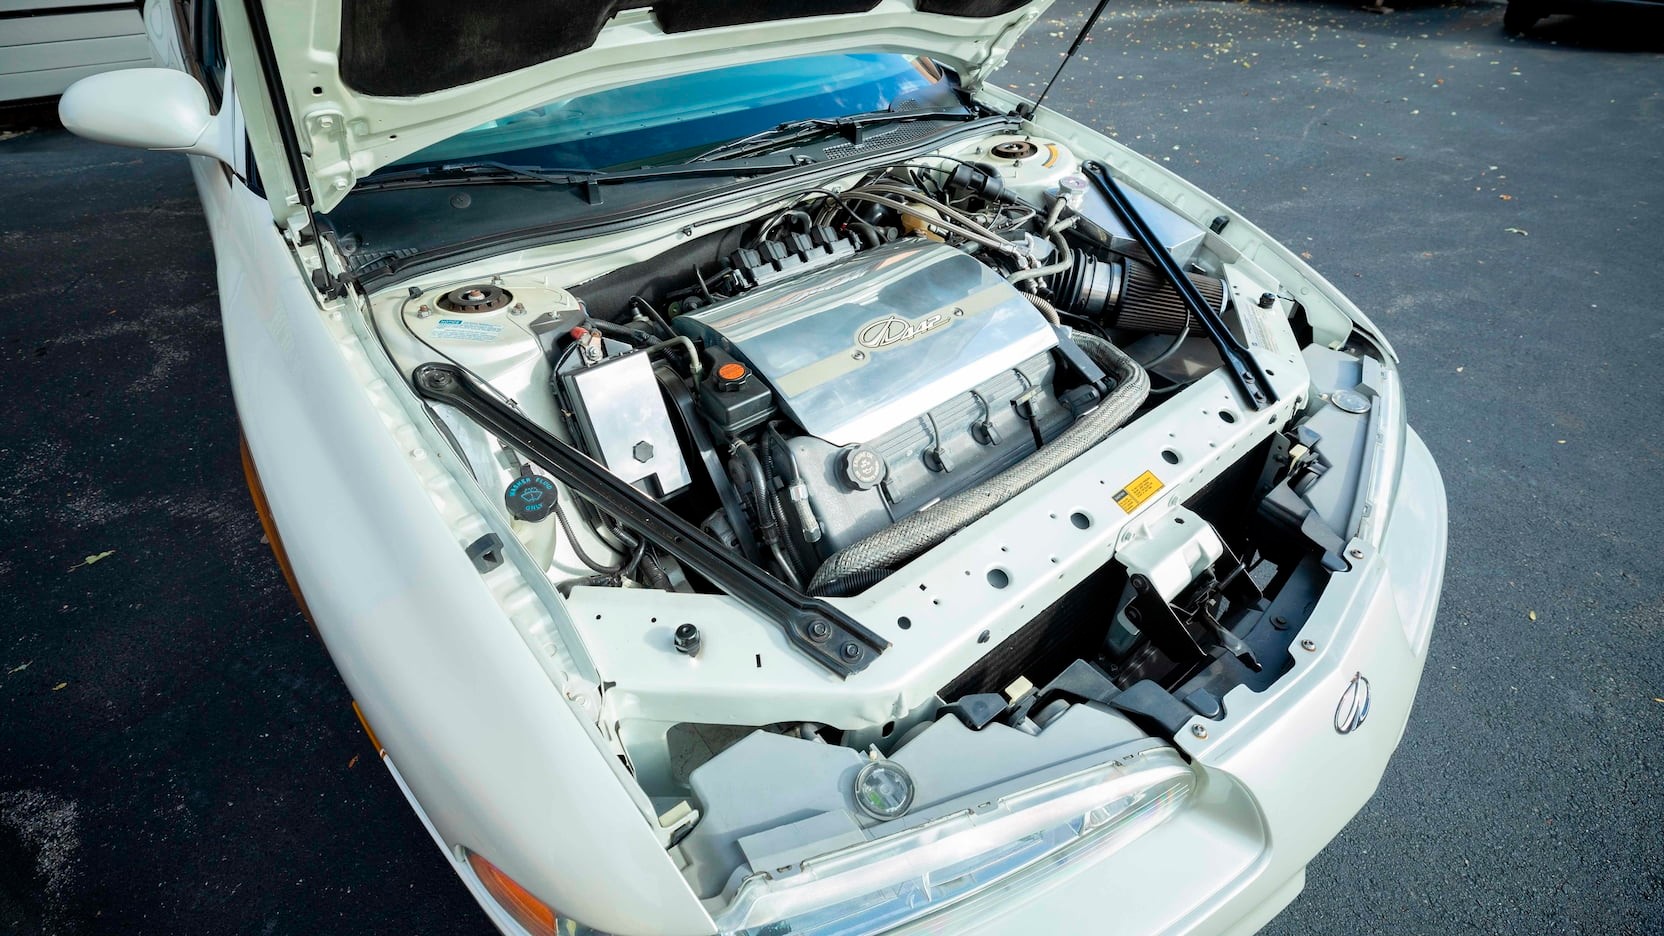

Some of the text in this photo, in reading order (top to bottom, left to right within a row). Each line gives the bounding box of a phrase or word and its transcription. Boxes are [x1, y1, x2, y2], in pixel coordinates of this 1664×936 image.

[509, 477, 553, 496] WASHER FLUID
[525, 503, 543, 511] ONLY
